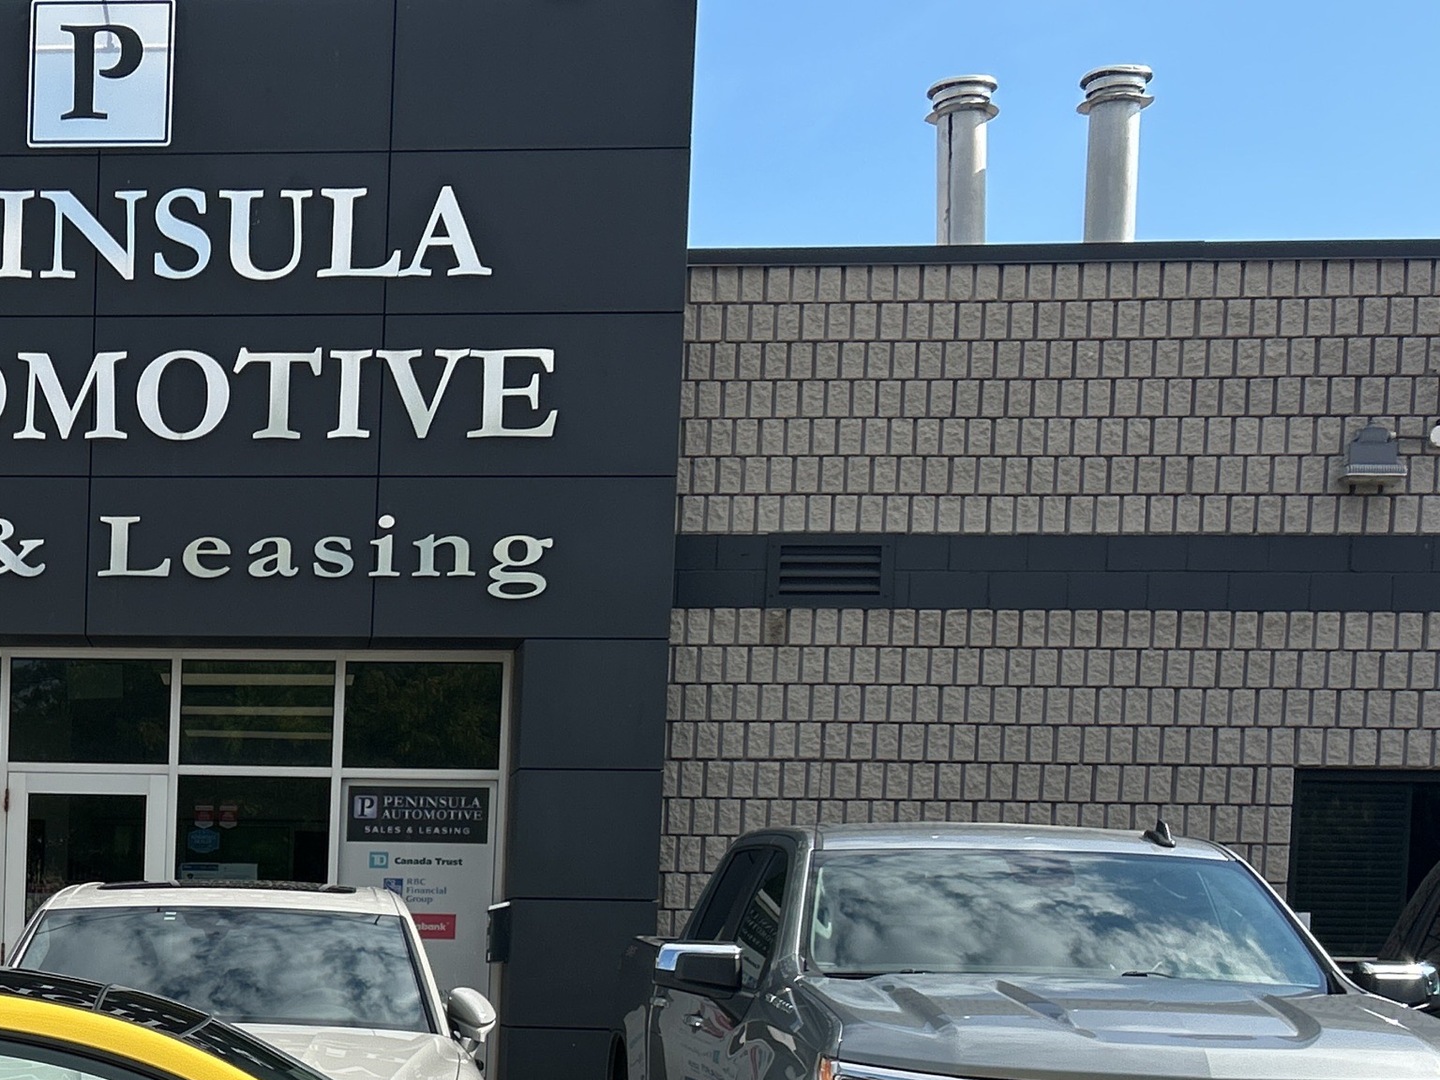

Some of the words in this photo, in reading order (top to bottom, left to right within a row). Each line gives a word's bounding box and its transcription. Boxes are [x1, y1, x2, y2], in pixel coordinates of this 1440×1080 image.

[60, 23, 144, 121] P
[97, 514, 554, 600] Leasing
[358, 797, 374, 817] P
[383, 795, 482, 809] PENINSULA
[382, 809, 483, 821] AUTOMOTIVE
[364, 825, 402, 834] SALES
[418, 826, 471, 835] LEASING
[371, 854, 387, 866] TD
[394, 857, 433, 866] Canada
[435, 857, 463, 866] Trust
[406, 886, 448, 895] Financial
[406, 895, 434, 905] Group
